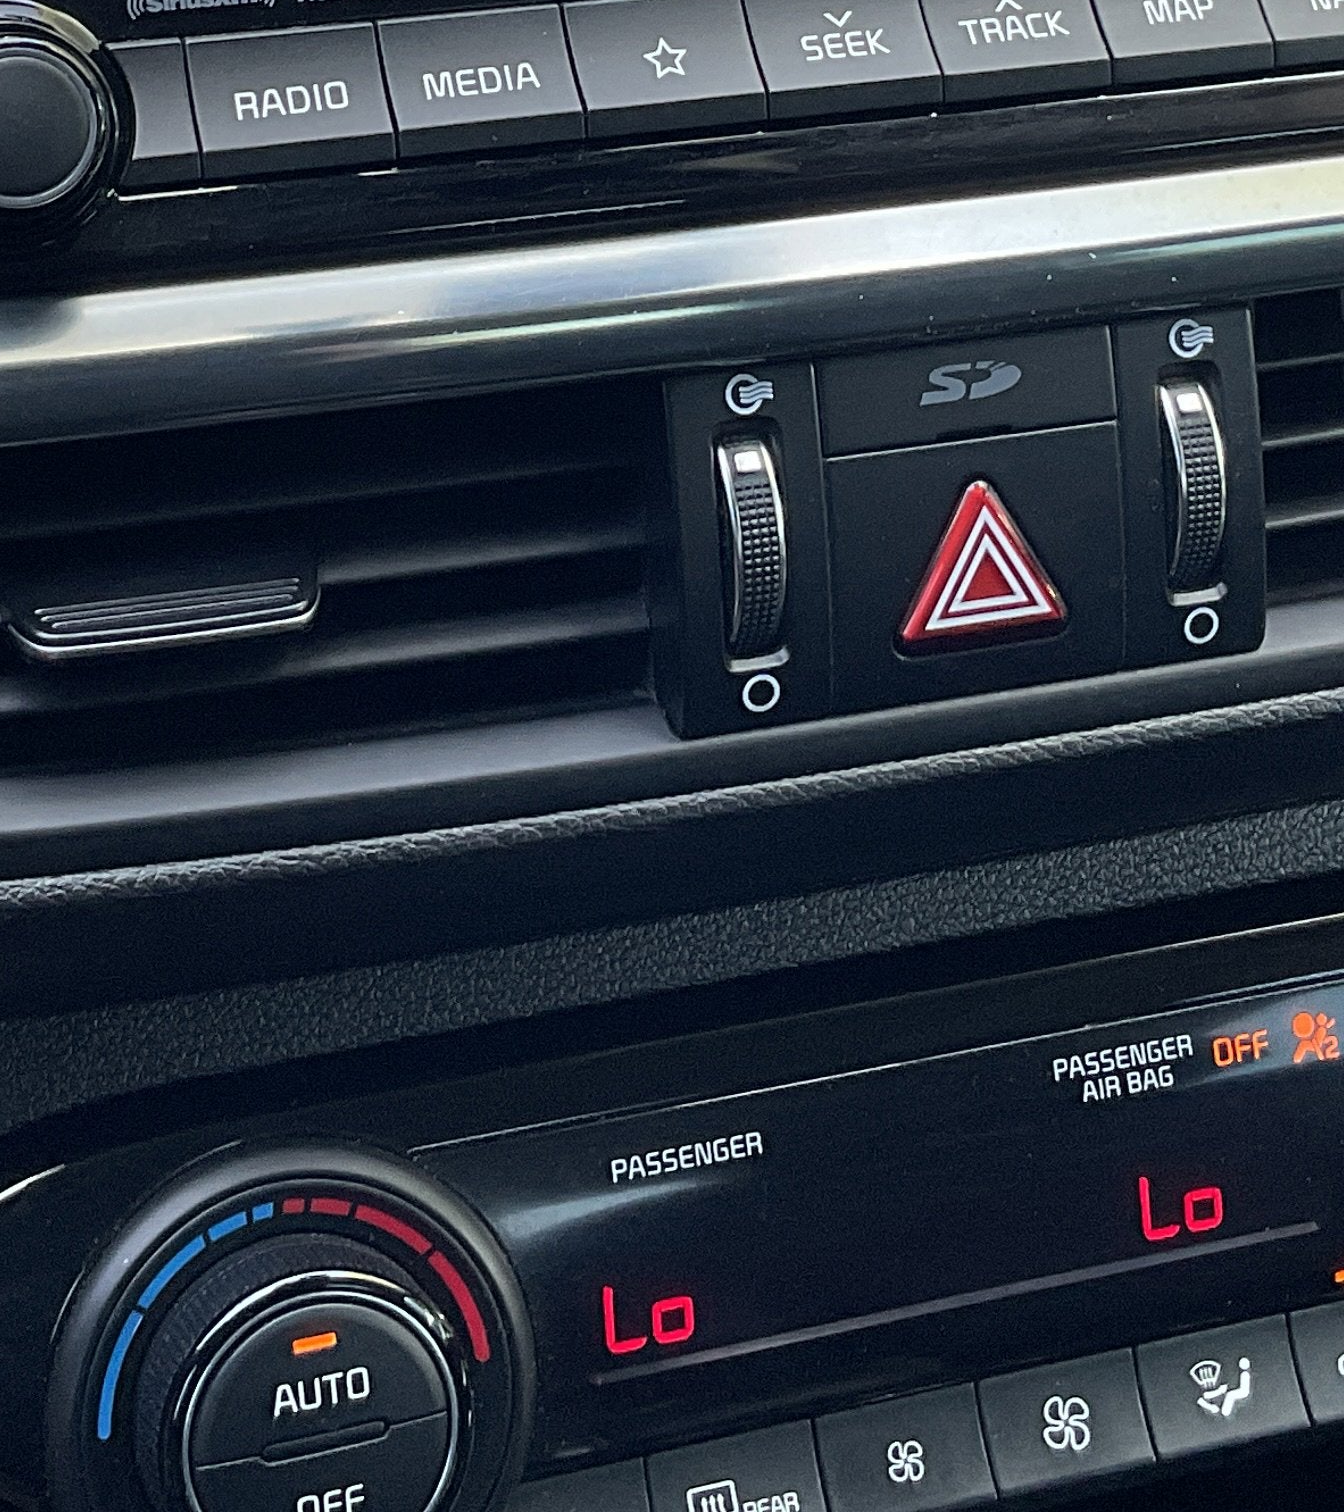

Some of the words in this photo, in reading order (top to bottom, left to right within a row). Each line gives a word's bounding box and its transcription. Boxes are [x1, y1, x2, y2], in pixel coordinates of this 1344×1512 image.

[800, 28, 891, 61] SEEK
[958, 10, 1070, 45] TRACK
[234, 80, 349, 121] RADIO
[422, 62, 541, 100] MEDIA
[920, 360, 1022, 406] SD
[1053, 1035, 1193, 1082] PASSENGER
[1212, 1029, 1269, 1068] OFF
[1082, 1076, 1121, 1103] AIR
[1127, 1065, 1174, 1093] BAG
[611, 1131, 763, 1183] PASSENGER
[1138, 1176, 1223, 1241] Lo
[602, 1285, 695, 1355] Lo
[273, 1366, 370, 1417] AUTO
